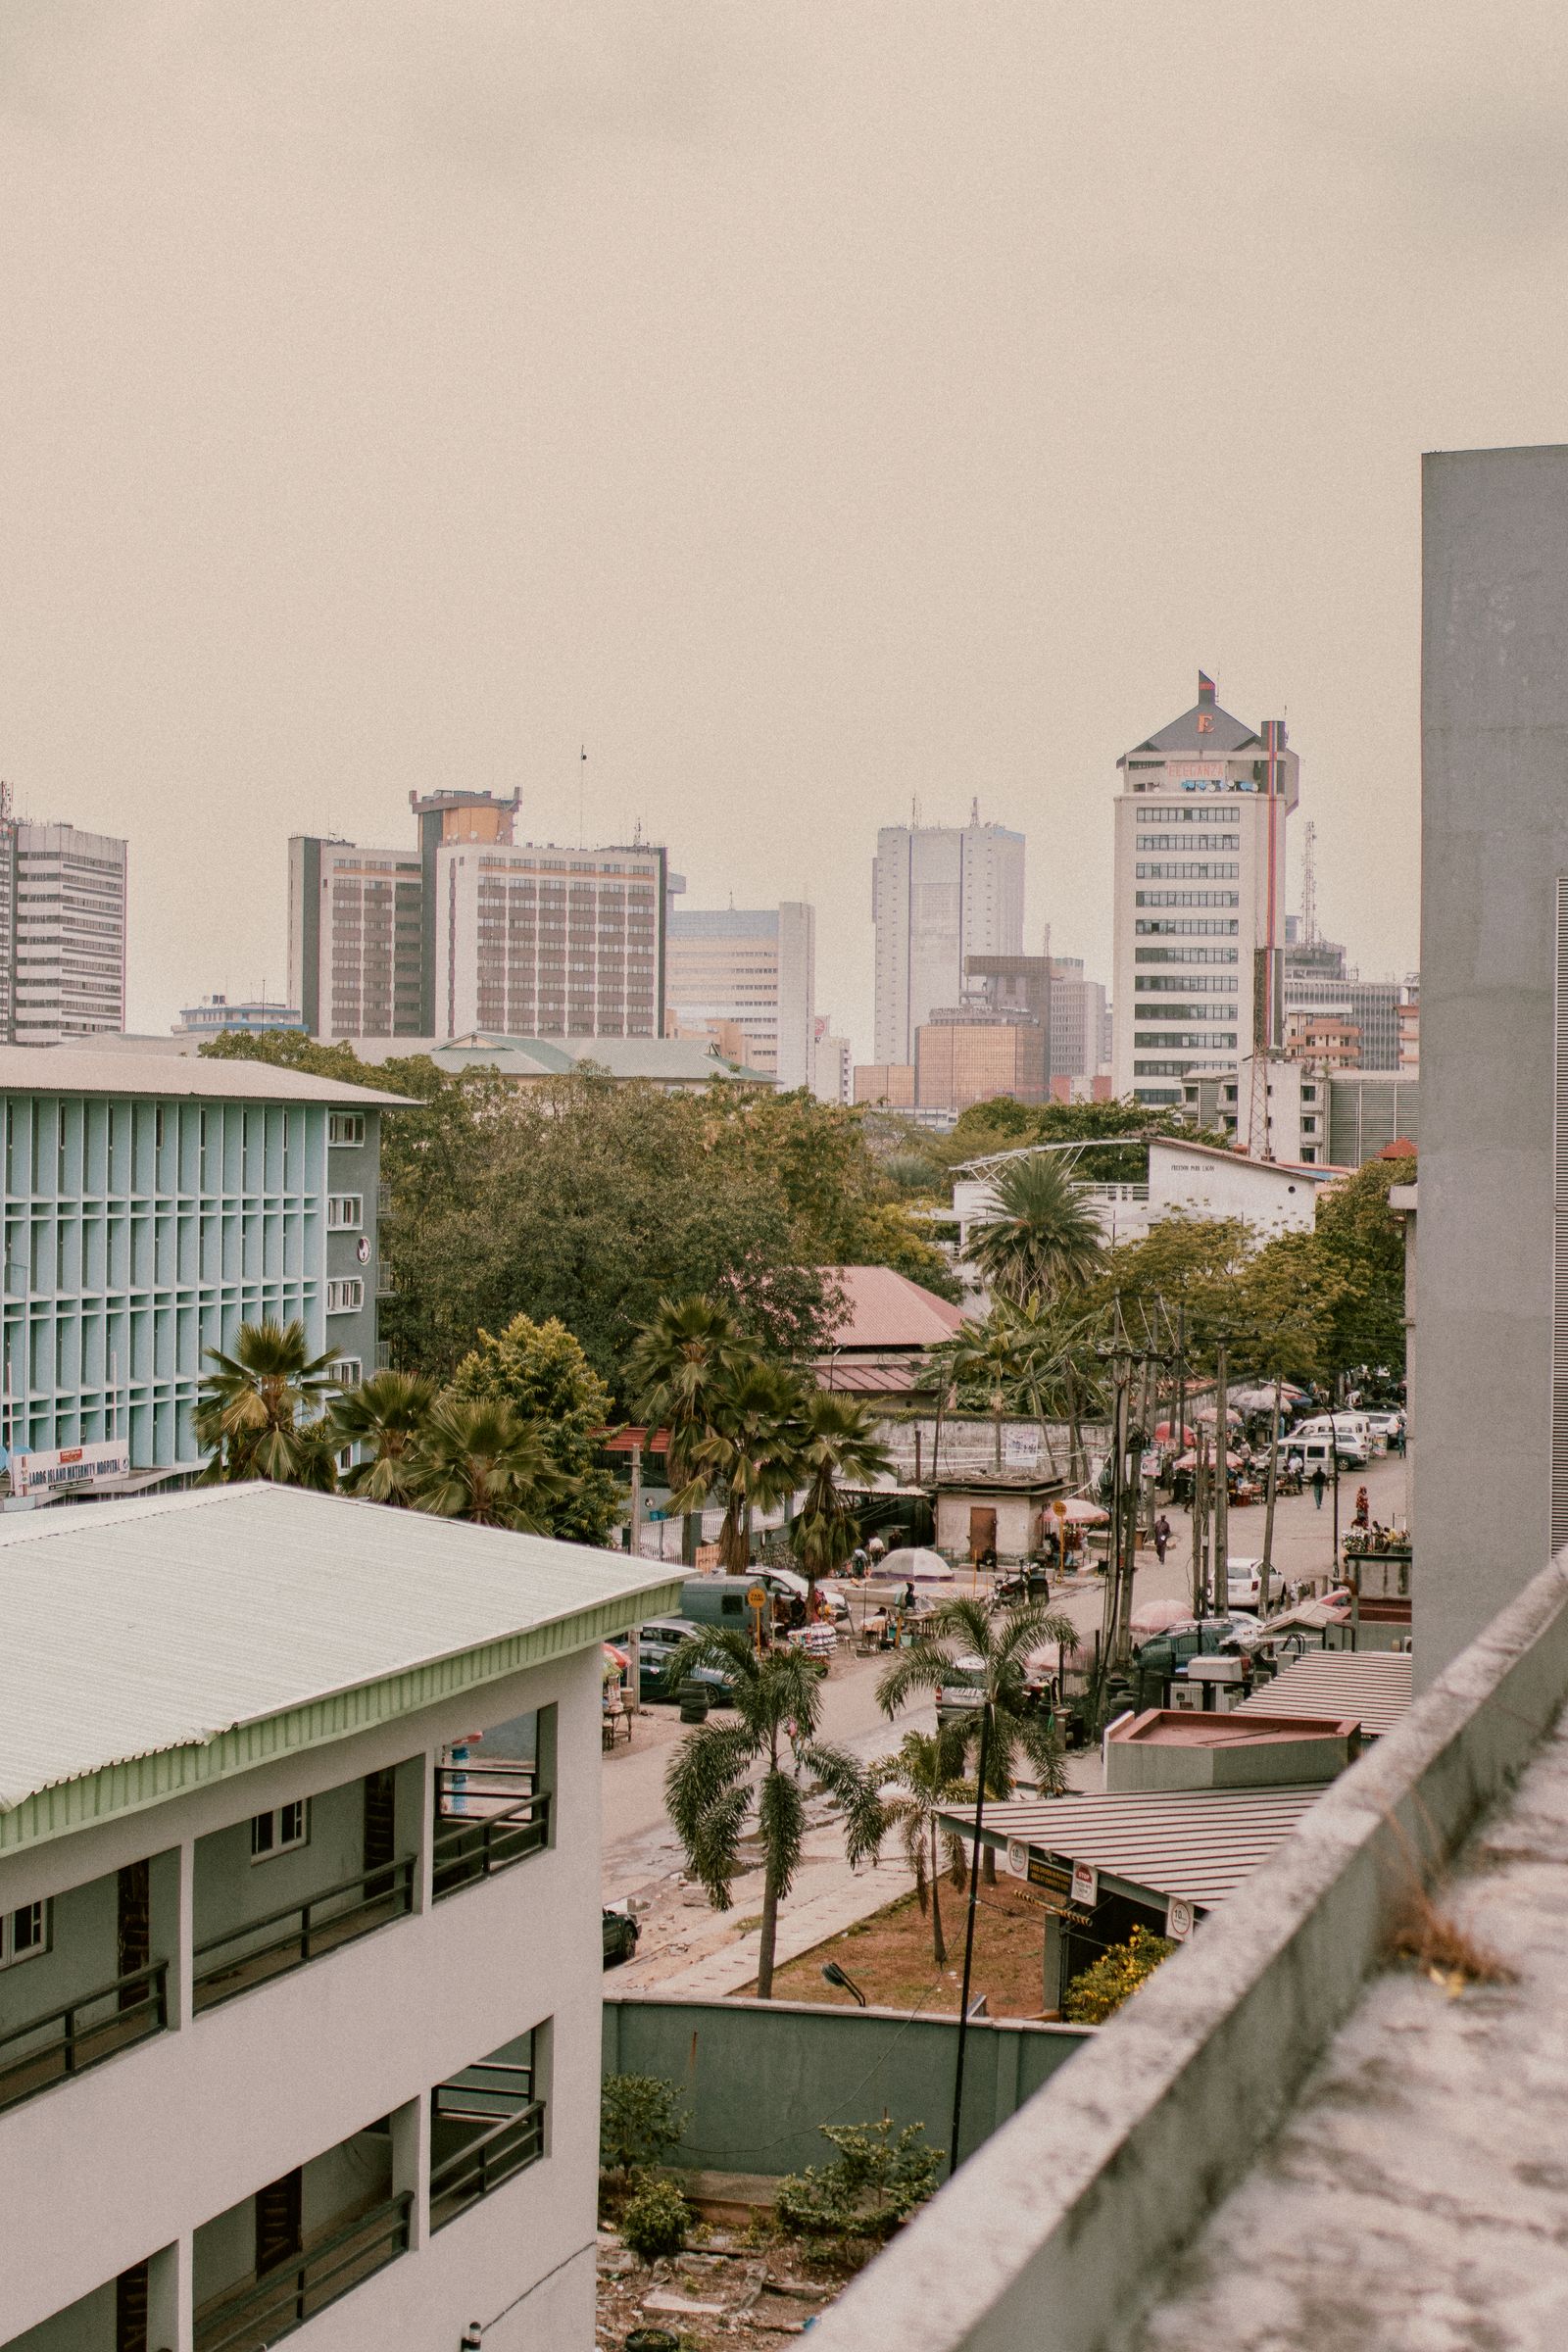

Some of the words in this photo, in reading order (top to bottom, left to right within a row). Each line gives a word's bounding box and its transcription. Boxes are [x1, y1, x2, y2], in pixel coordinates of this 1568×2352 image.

[1197, 713, 1216, 734] E
[1168, 764, 1224, 777] ELEGANZA
[29, 1471, 46, 1486] LAGOS
[47, 1467, 67, 1484] ISLAND
[67, 1463, 95, 1480] MATERNITY
[96, 1458, 121, 1475] HOSPITAL
[1012, 1848, 1019, 1858] 10
[1174, 1908, 1183, 1920] 10
